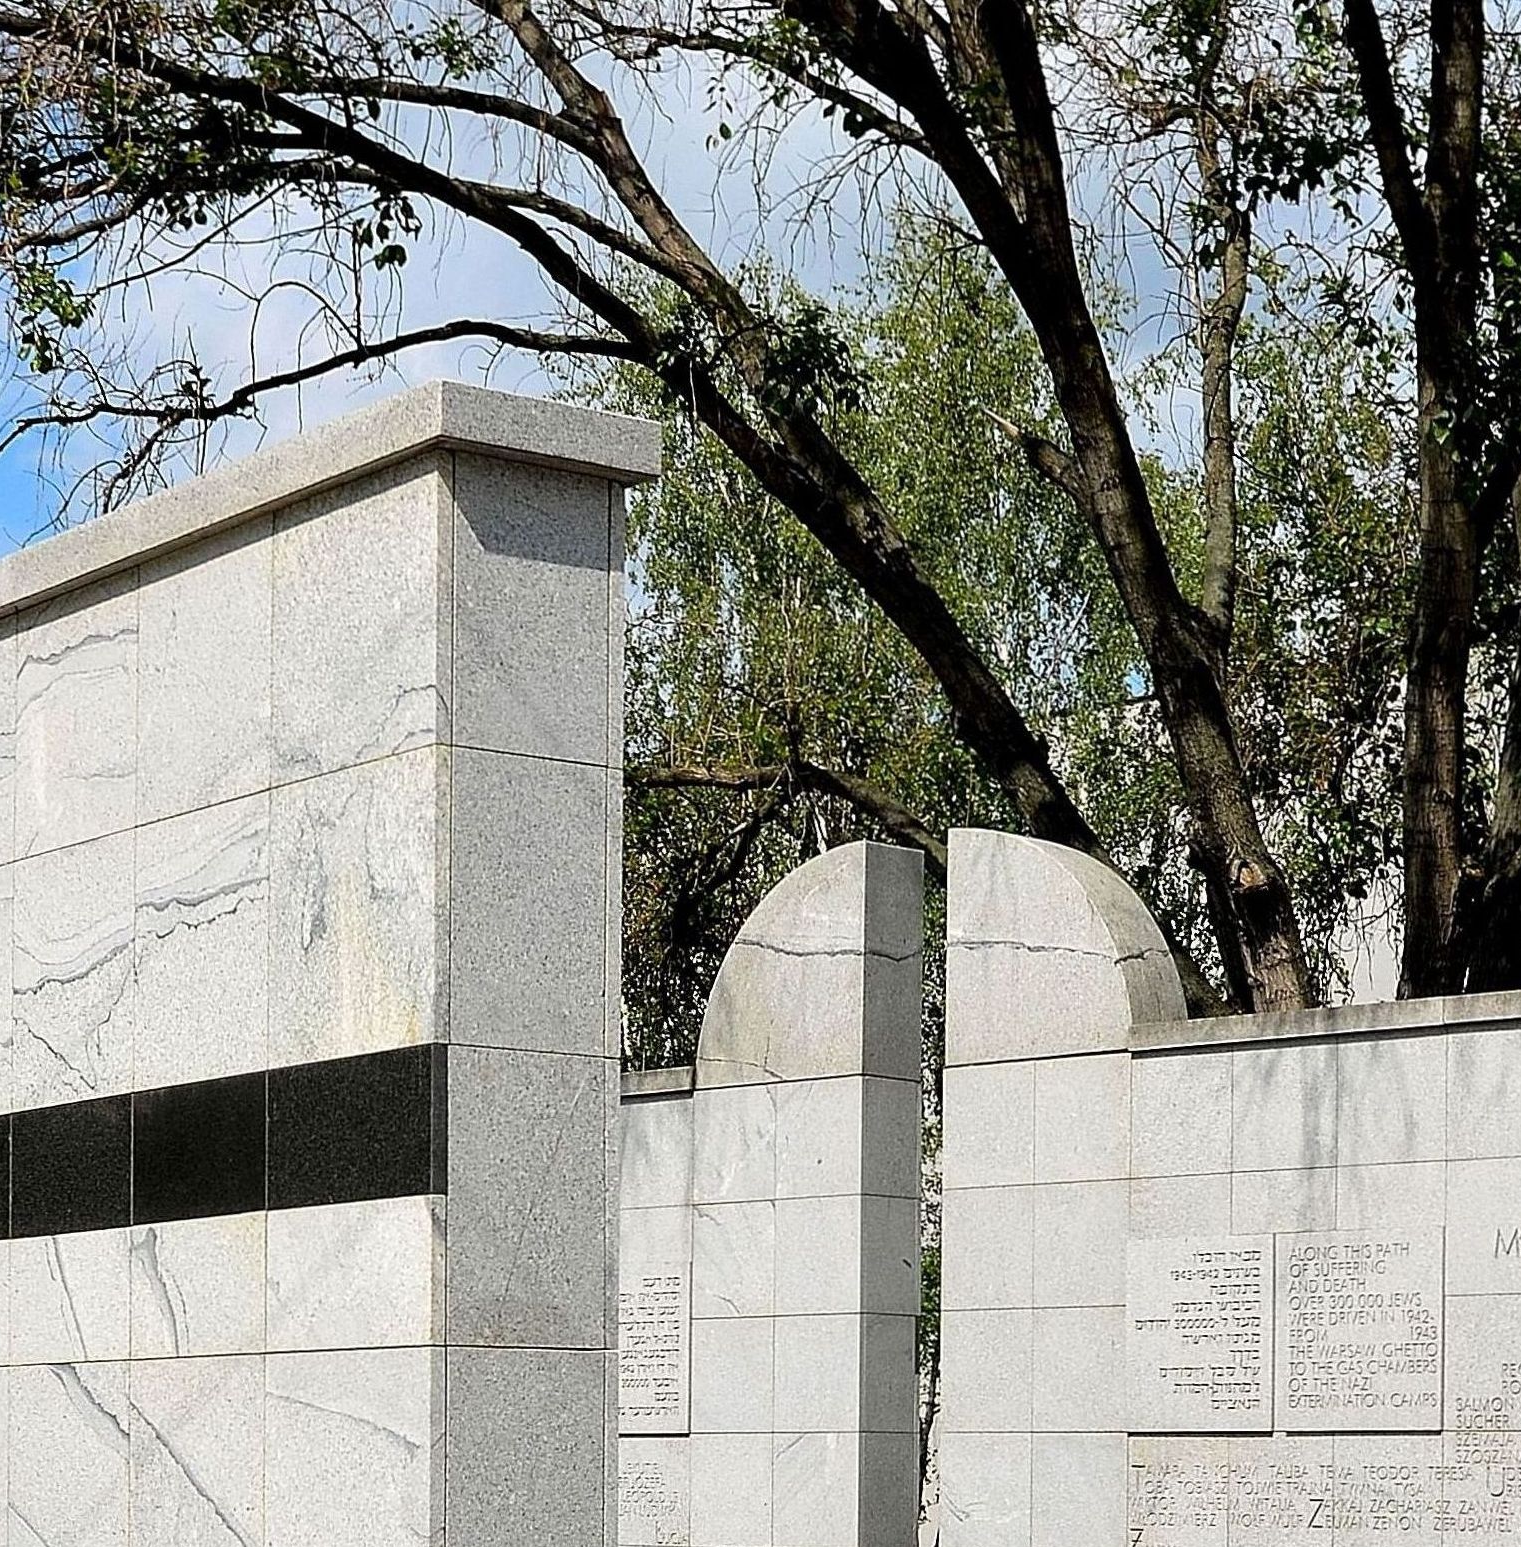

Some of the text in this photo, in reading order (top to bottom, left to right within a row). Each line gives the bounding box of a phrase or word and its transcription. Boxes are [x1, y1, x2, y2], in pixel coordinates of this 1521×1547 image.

[1288, 1241, 1411, 1262] ALONG THIS PATH
[1288, 1259, 1387, 1279] OF SUFFERING
[1288, 1278, 1367, 1294] AND DEATH
[1288, 1291, 1423, 1311] OVER 300 000 JEWS
[1288, 1311, 1325, 1327] WERE
[1328, 1310, 1377, 1326] DRIVEN
[1379, 1309, 1396, 1323] IN
[1288, 1325, 1439, 1343] FROM 1943
[1287, 1341, 1439, 1360] THE WARSAW GHETTO
[1287, 1358, 1438, 1377] TO THE GAS CHAMBERS
[1287, 1376, 1373, 1393] OF THE NAZI
[1287, 1392, 1439, 1409] EXTERMINATION CAMPS
